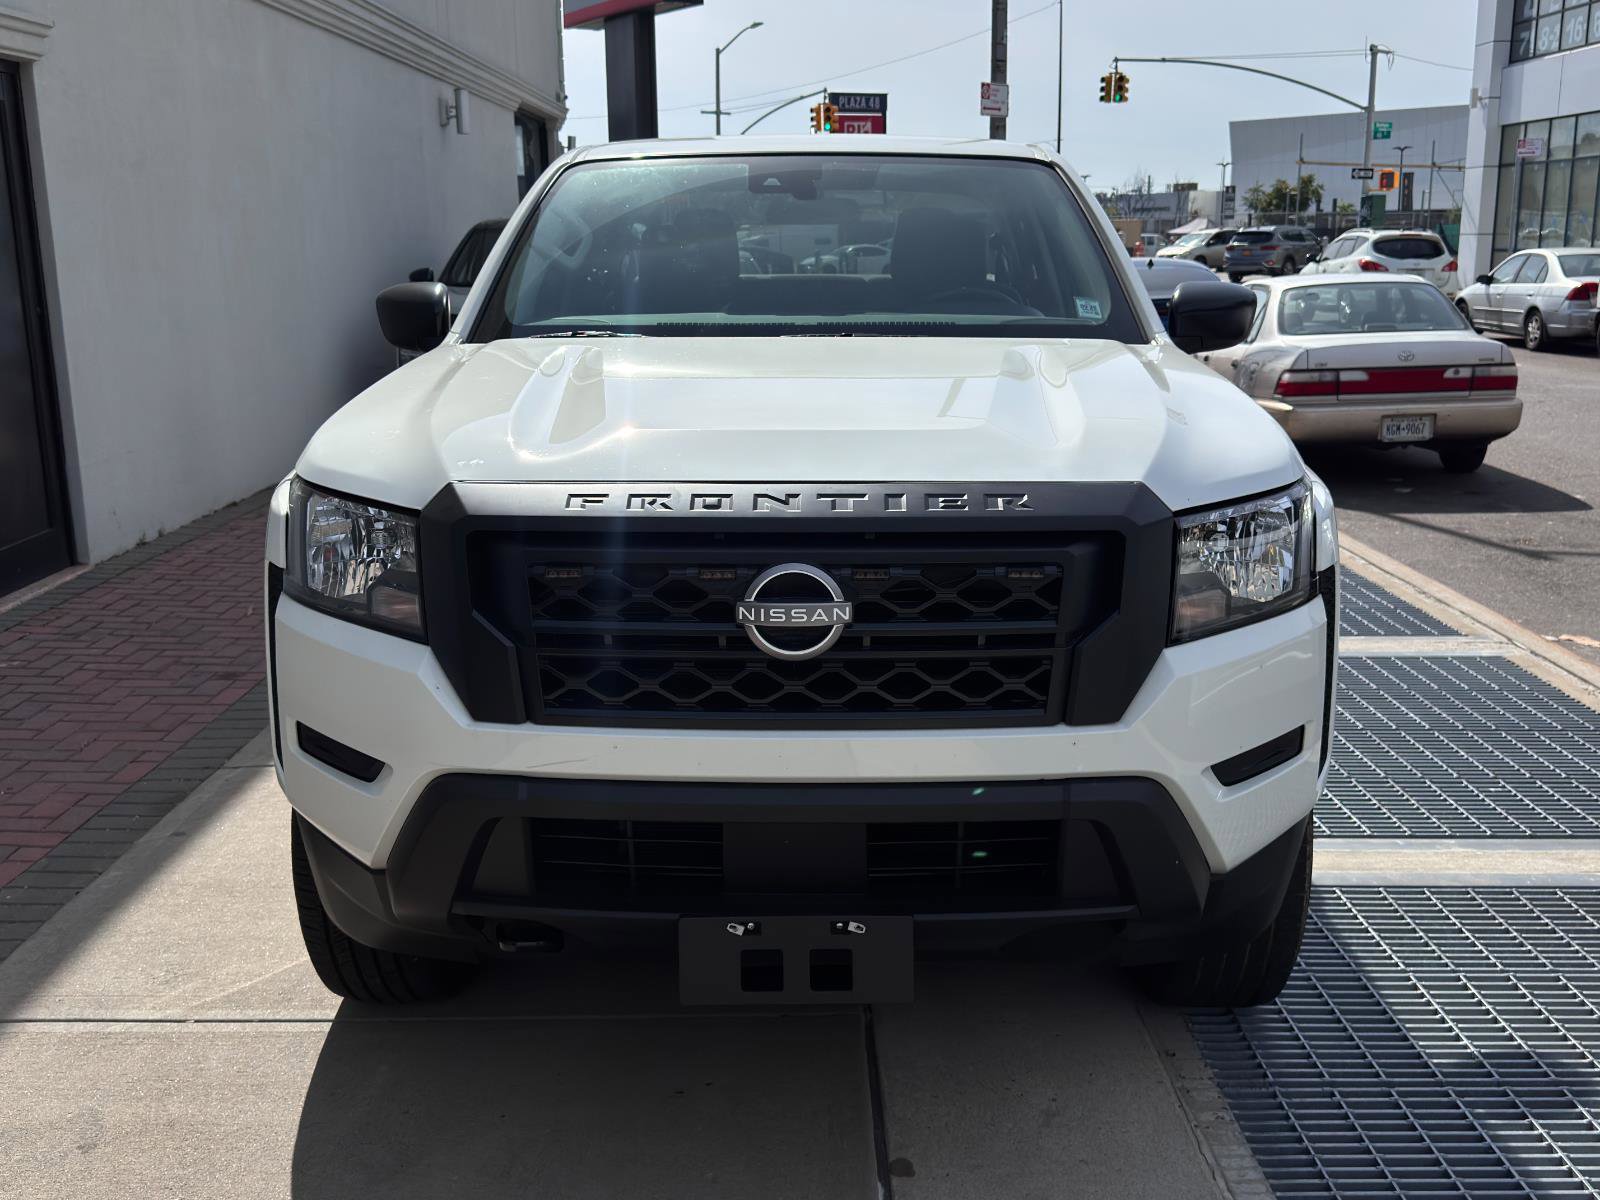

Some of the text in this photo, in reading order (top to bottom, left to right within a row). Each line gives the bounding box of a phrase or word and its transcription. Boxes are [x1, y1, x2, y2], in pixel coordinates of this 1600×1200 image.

[838, 95, 867, 109] PLAZA
[564, 493, 1034, 512] FRONTIER
[738, 606, 850, 622] NISSAN
